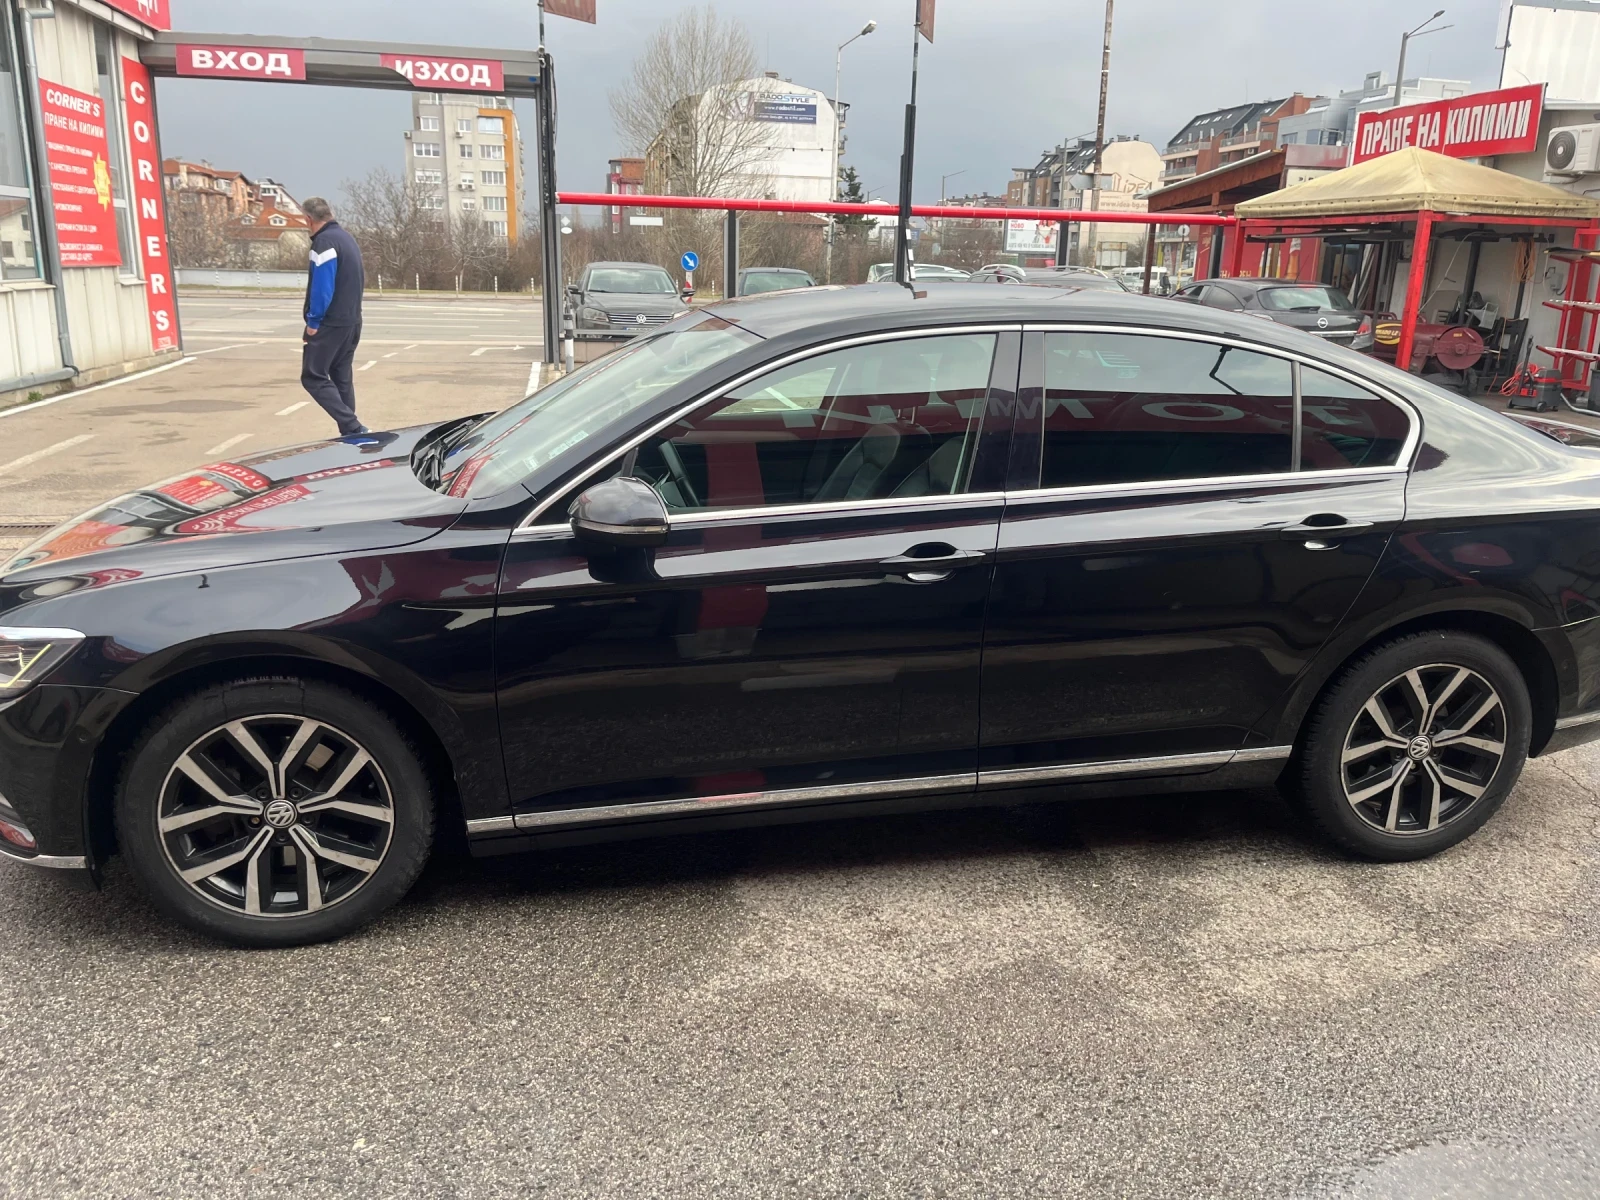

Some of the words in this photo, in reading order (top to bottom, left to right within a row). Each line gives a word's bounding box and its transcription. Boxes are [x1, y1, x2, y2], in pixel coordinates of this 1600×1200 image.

[191, 49, 292, 76] ВХОД
[395, 59, 491, 87] ИЗХОД
[45, 111, 68, 130] ПРАНЕ
[68, 118, 78, 132] НА
[1360, 115, 1414, 156] ПРАНЕ
[1416, 111, 1441, 148] НА
[1445, 99, 1533, 145] КИЛИМИ
